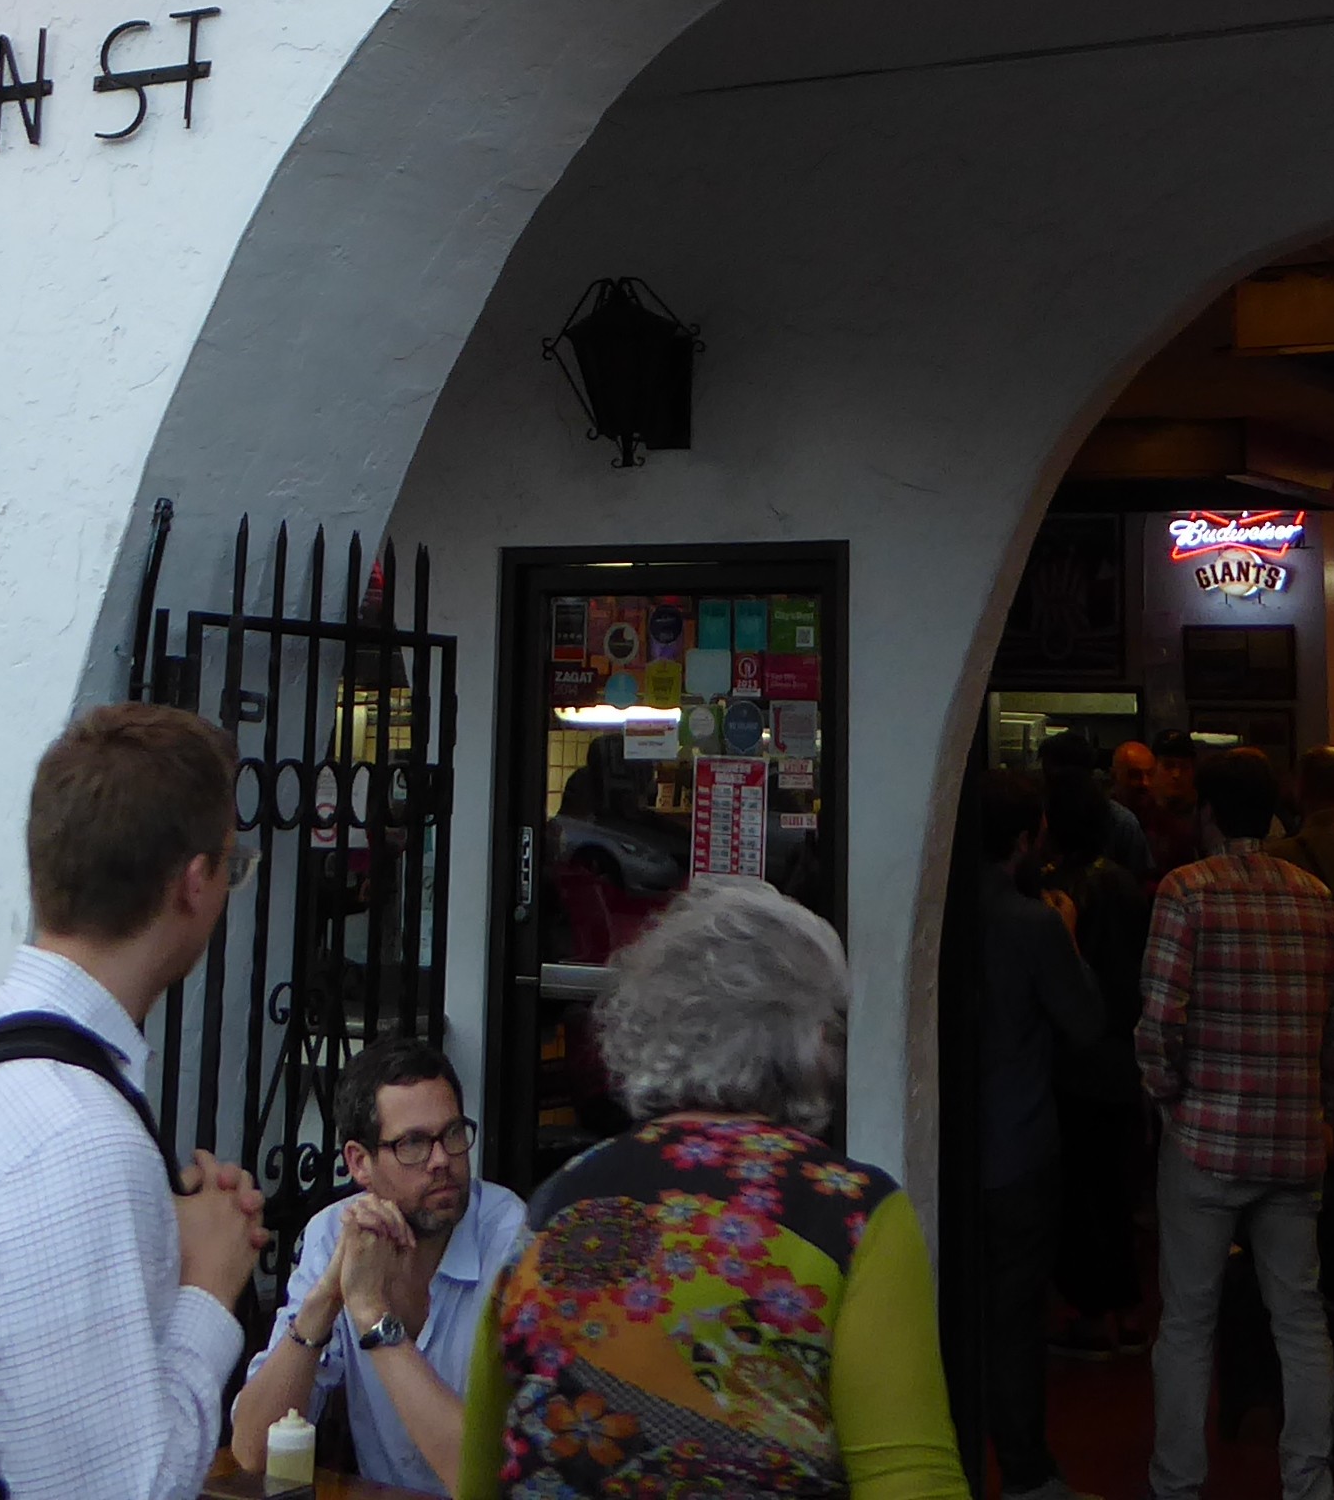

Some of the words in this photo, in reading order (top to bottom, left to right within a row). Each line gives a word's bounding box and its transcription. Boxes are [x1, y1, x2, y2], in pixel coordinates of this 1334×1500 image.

[93, 7, 223, 142] ST
[1169, 519, 1303, 548] Budweiser
[1195, 560, 1282, 590] GIANTS
